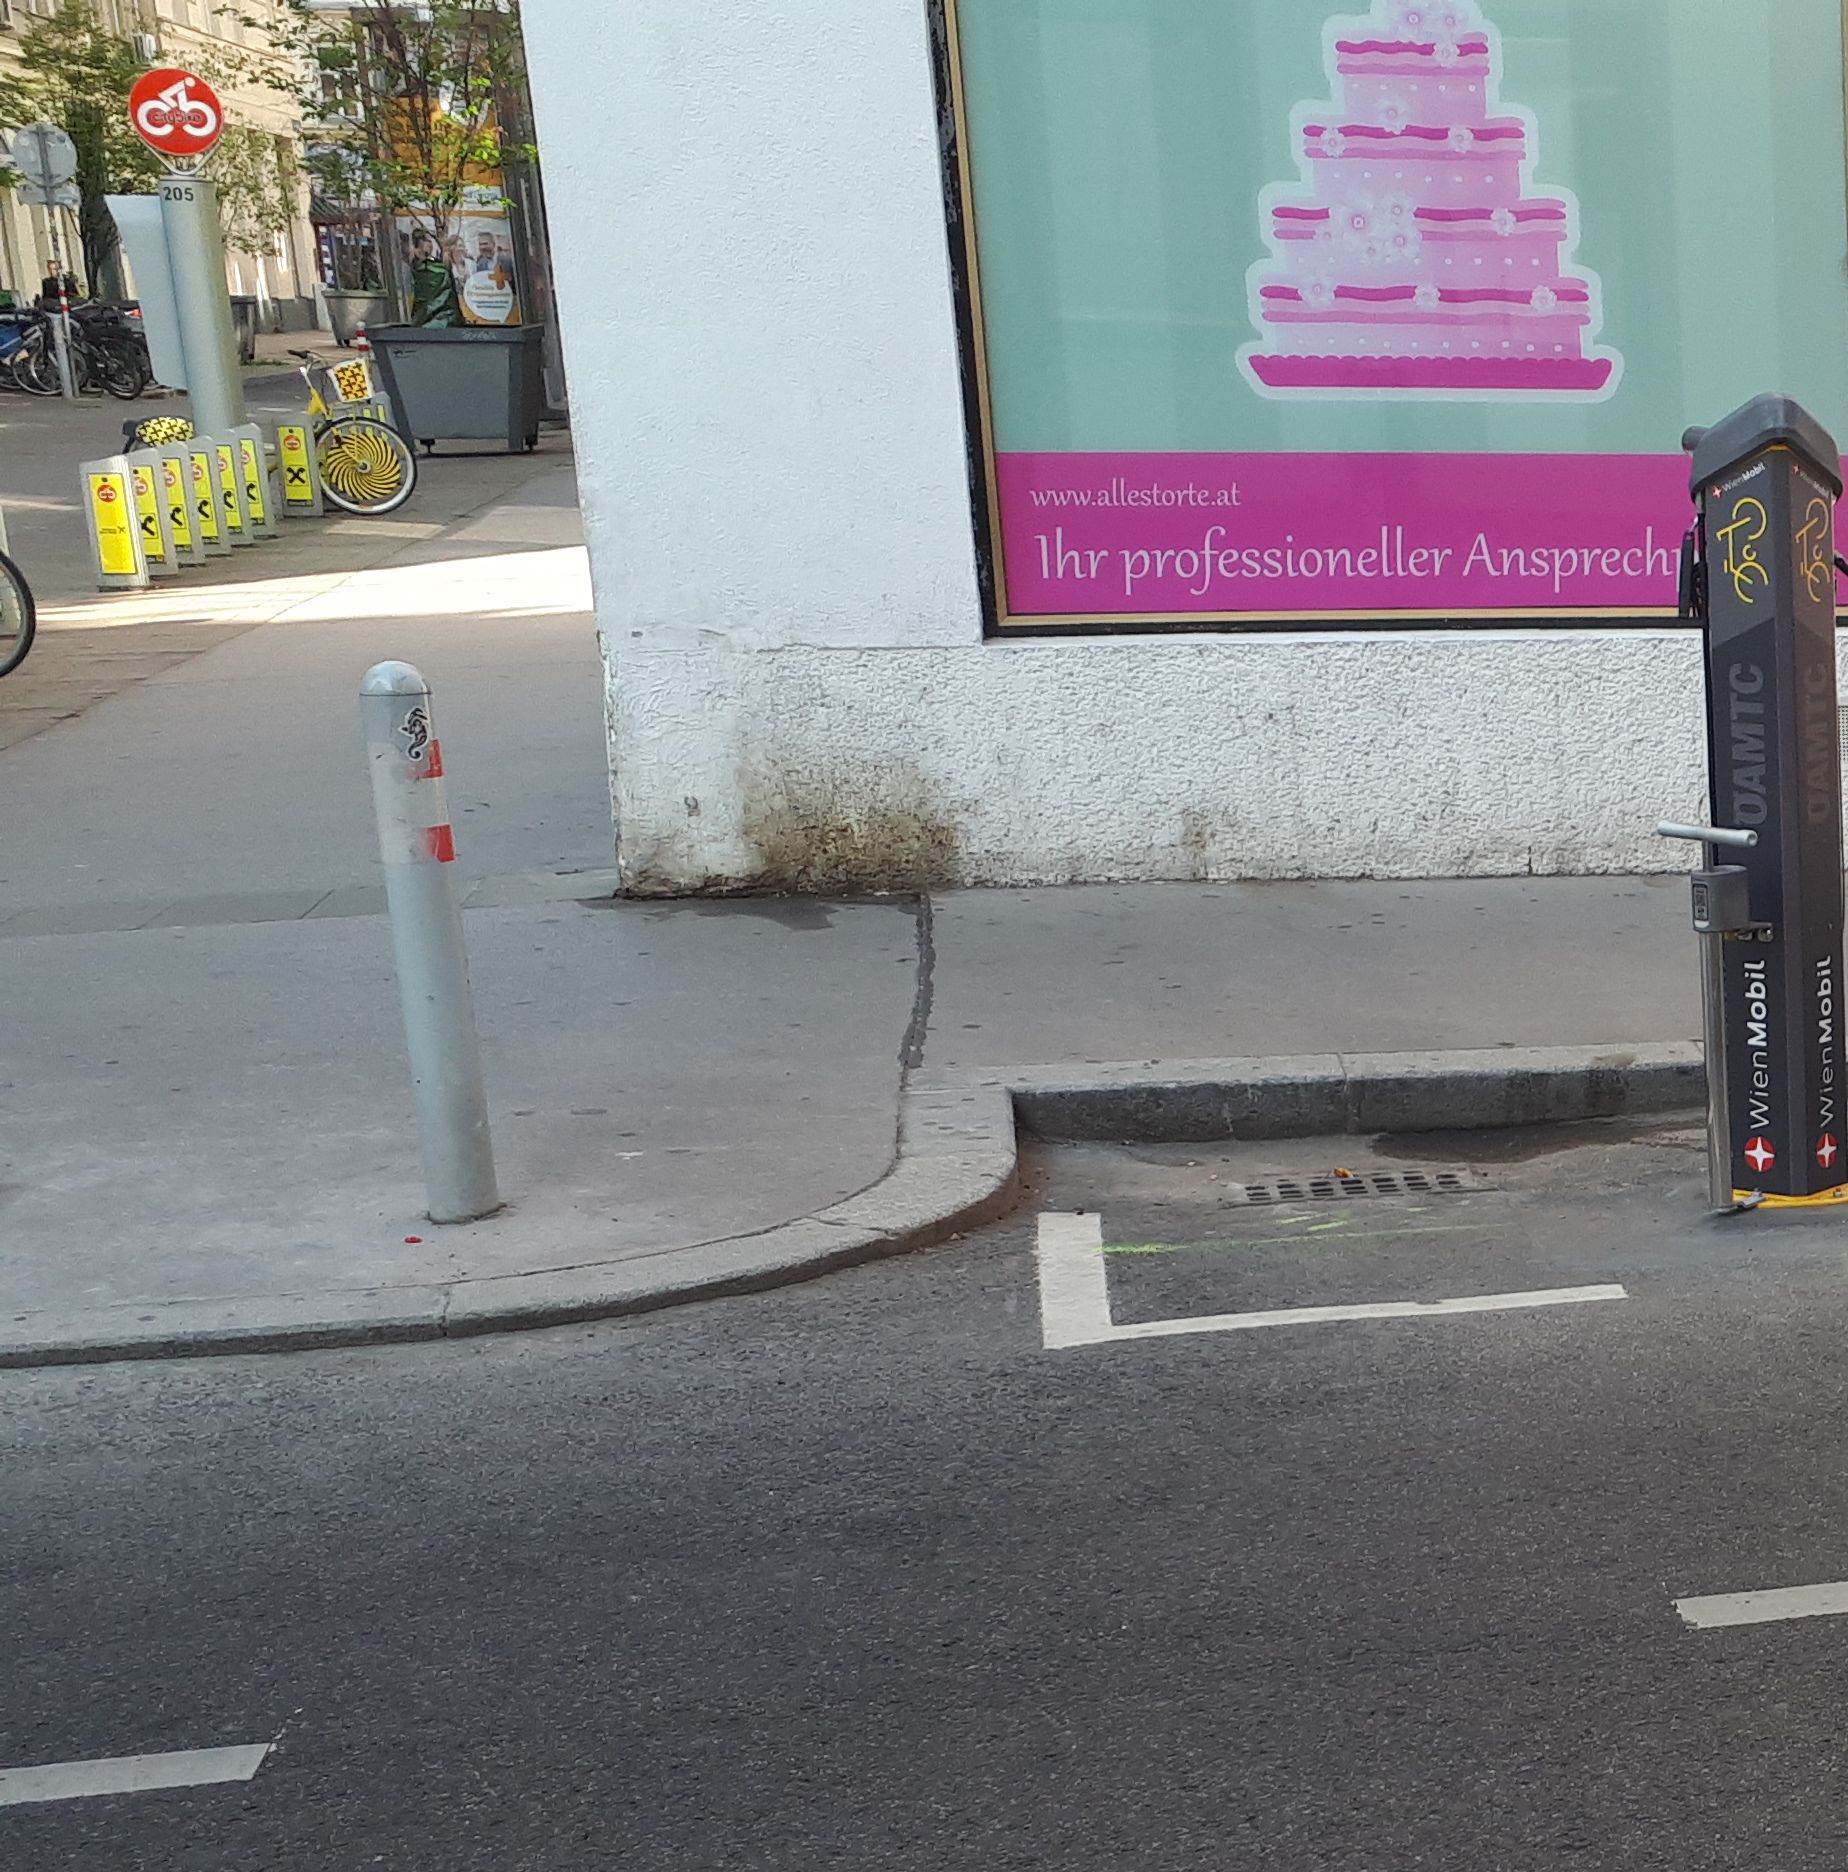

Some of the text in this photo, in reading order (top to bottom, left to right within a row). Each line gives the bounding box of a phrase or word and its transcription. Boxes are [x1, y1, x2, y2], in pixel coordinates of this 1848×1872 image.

[163, 186, 195, 202] 205
[1031, 477, 1241, 507] www.allestorte.at
[1722, 461, 1766, 492] WienMobil
[1035, 527, 1108, 580] Ihr
[1120, 526, 1452, 596] professioneller
[1743, 959, 1769, 1130] WienMobil
[1816, 955, 1833, 1129] WienMobil
